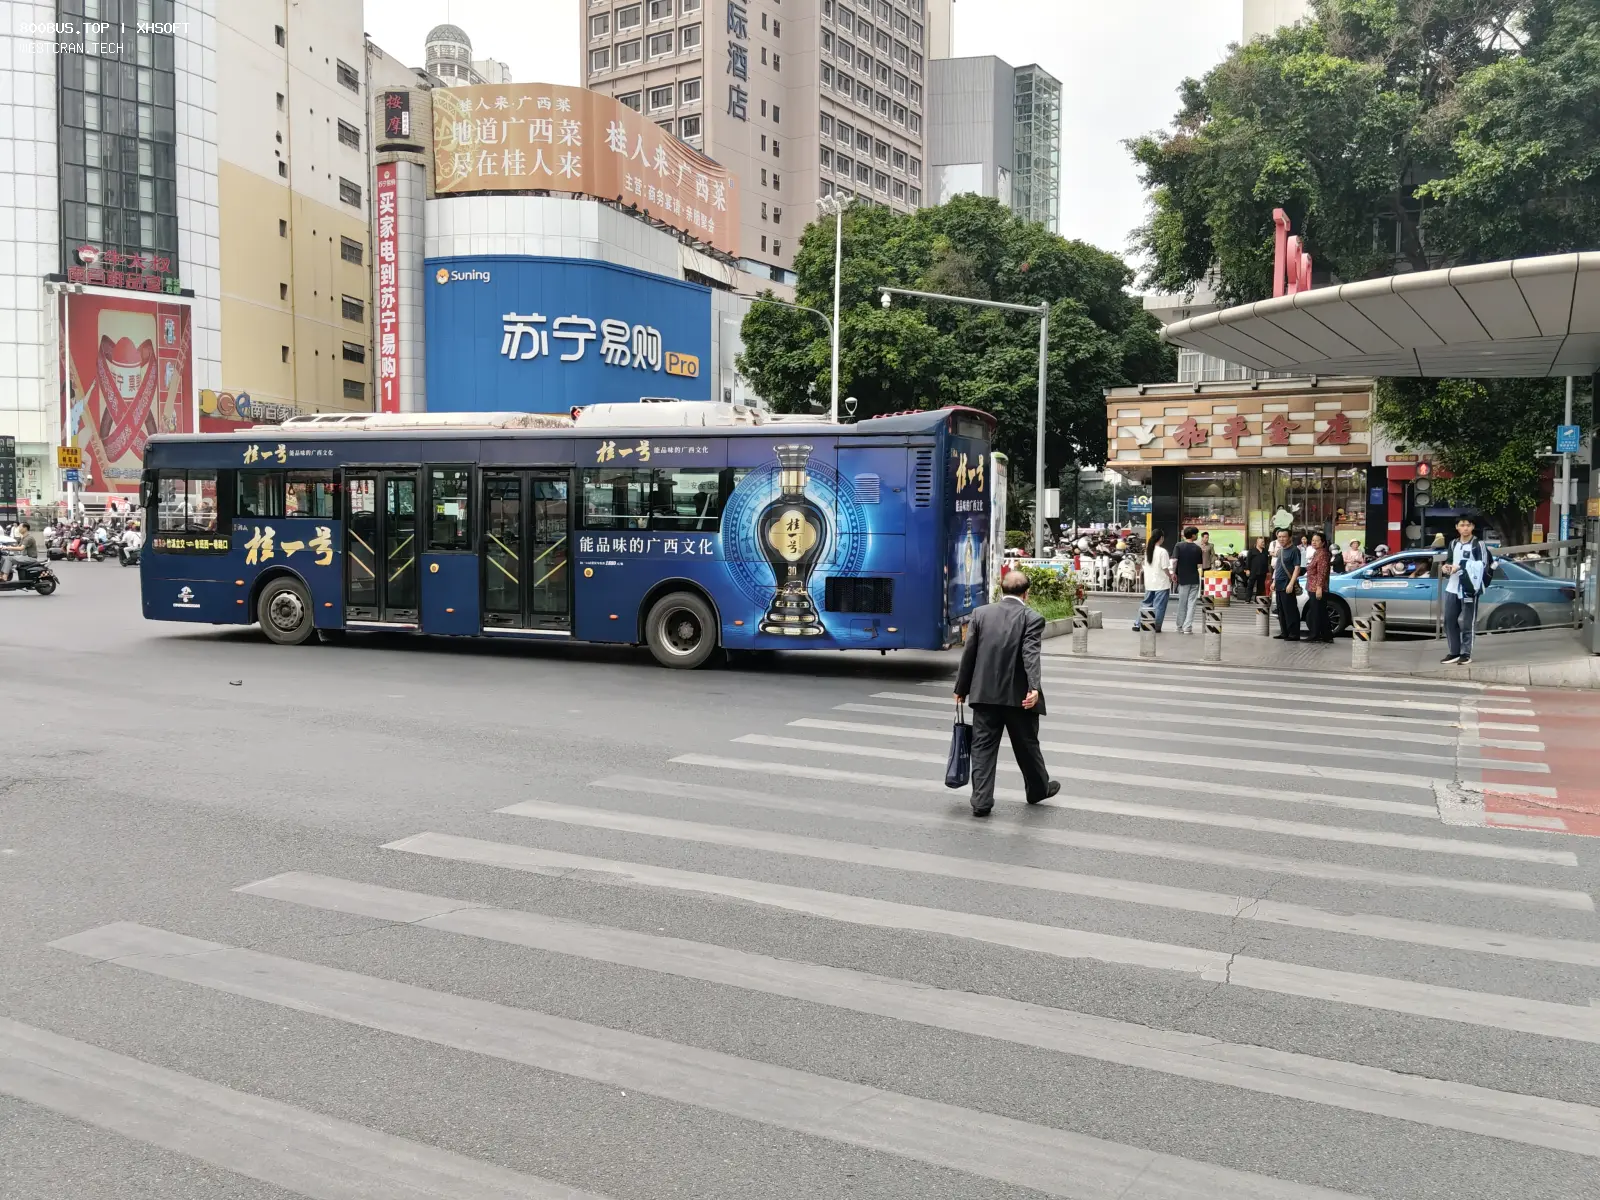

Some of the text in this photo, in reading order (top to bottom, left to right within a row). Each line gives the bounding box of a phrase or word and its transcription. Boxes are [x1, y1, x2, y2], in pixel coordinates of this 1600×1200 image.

[726, 0, 748, 122] 际酒店
[386, 94, 403, 135] 按摩
[452, 116, 582, 147] 地道广西菜
[452, 148, 583, 179] 尽在桂人来
[451, 269, 490, 283] Suning
[379, 191, 396, 413] 买家电到苏宁易购1
[500, 312, 697, 375] 苏宁易购 Pro
[243, 443, 287, 464] 桂一号
[596, 440, 709, 463] 桂一号 能品味的广西文化
[955, 452, 984, 494] 桂一号
[1133, 495, 1152, 505] iQ
[244, 526, 334, 566] 桂一号
[579, 536, 714, 555] 能品味的广西文化
[786, 517, 800, 554] 桂一号
